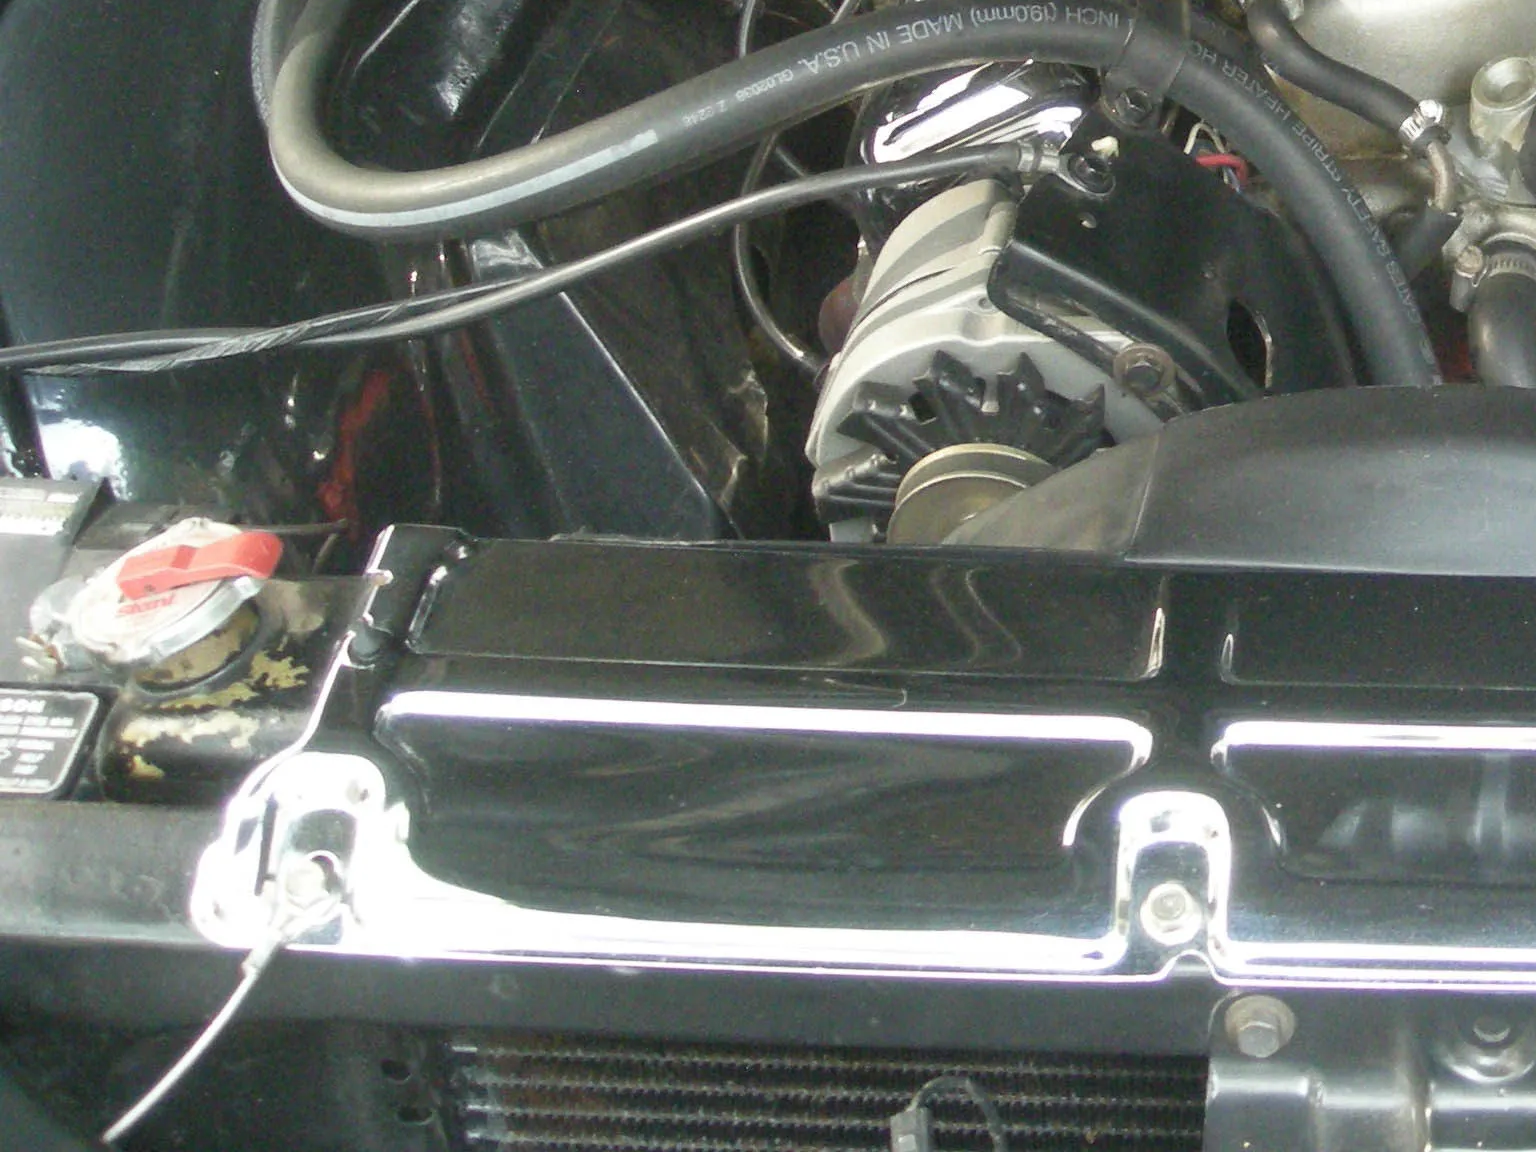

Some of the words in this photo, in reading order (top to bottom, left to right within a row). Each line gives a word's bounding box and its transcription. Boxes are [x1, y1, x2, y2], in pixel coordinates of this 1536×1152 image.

[896, 11, 964, 45] MADE
[1065, 4, 1119, 29] INCH
[798, 36, 862, 76] U.S.A.
[867, 31, 890, 54] IN
[1220, 59, 1293, 121] HEATER
